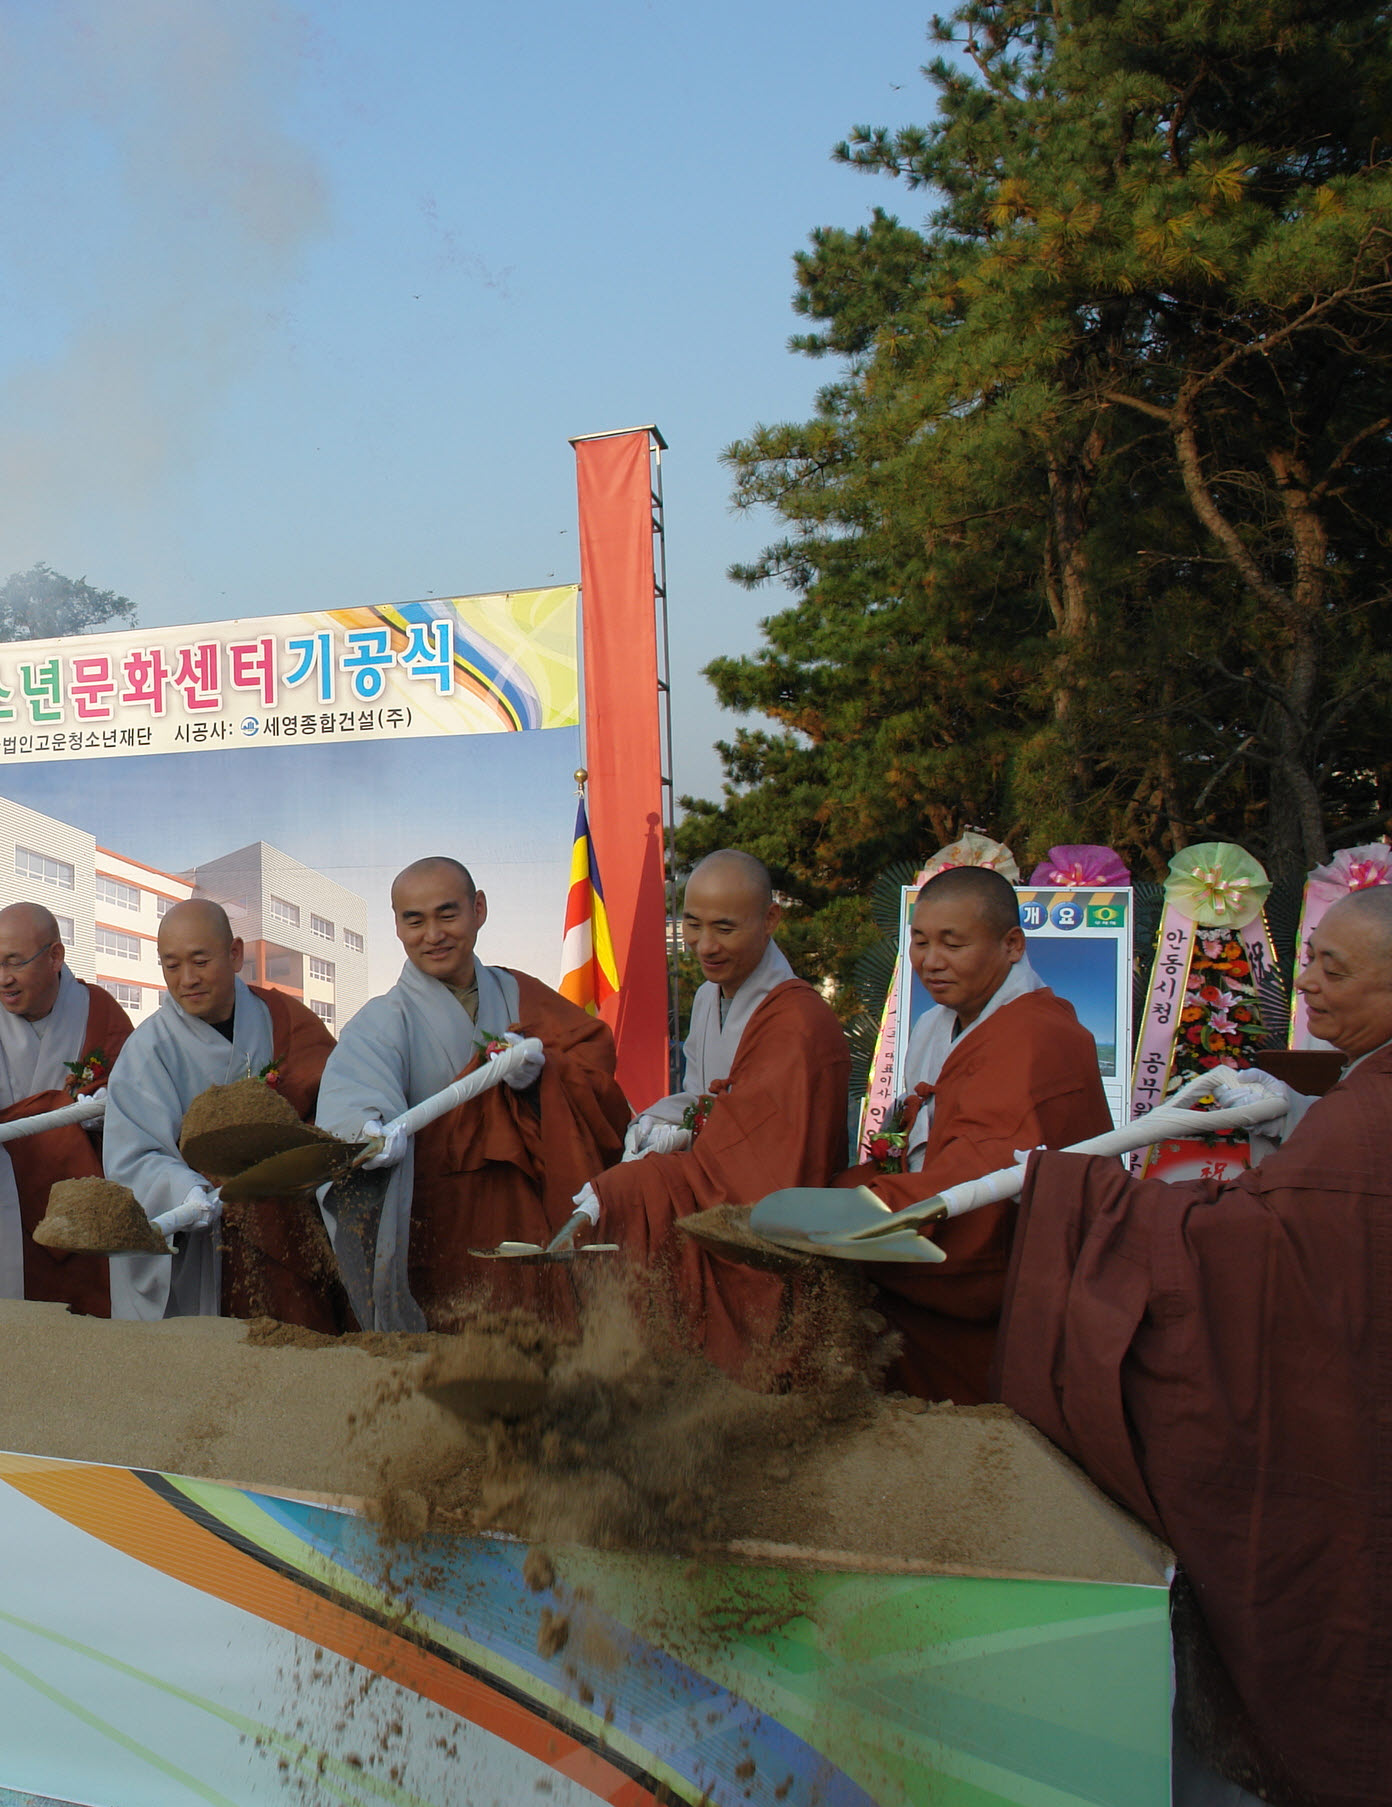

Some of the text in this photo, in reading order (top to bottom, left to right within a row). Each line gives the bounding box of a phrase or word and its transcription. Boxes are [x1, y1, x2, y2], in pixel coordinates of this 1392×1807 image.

[71, 638, 274, 718] 문화센터
[286, 624, 454, 700] 기공식
[174, 720, 233, 743] 시공사:
[263, 707, 412, 736] 세영종합건설(주)
[1152, 929, 1188, 1024] 안동시청
